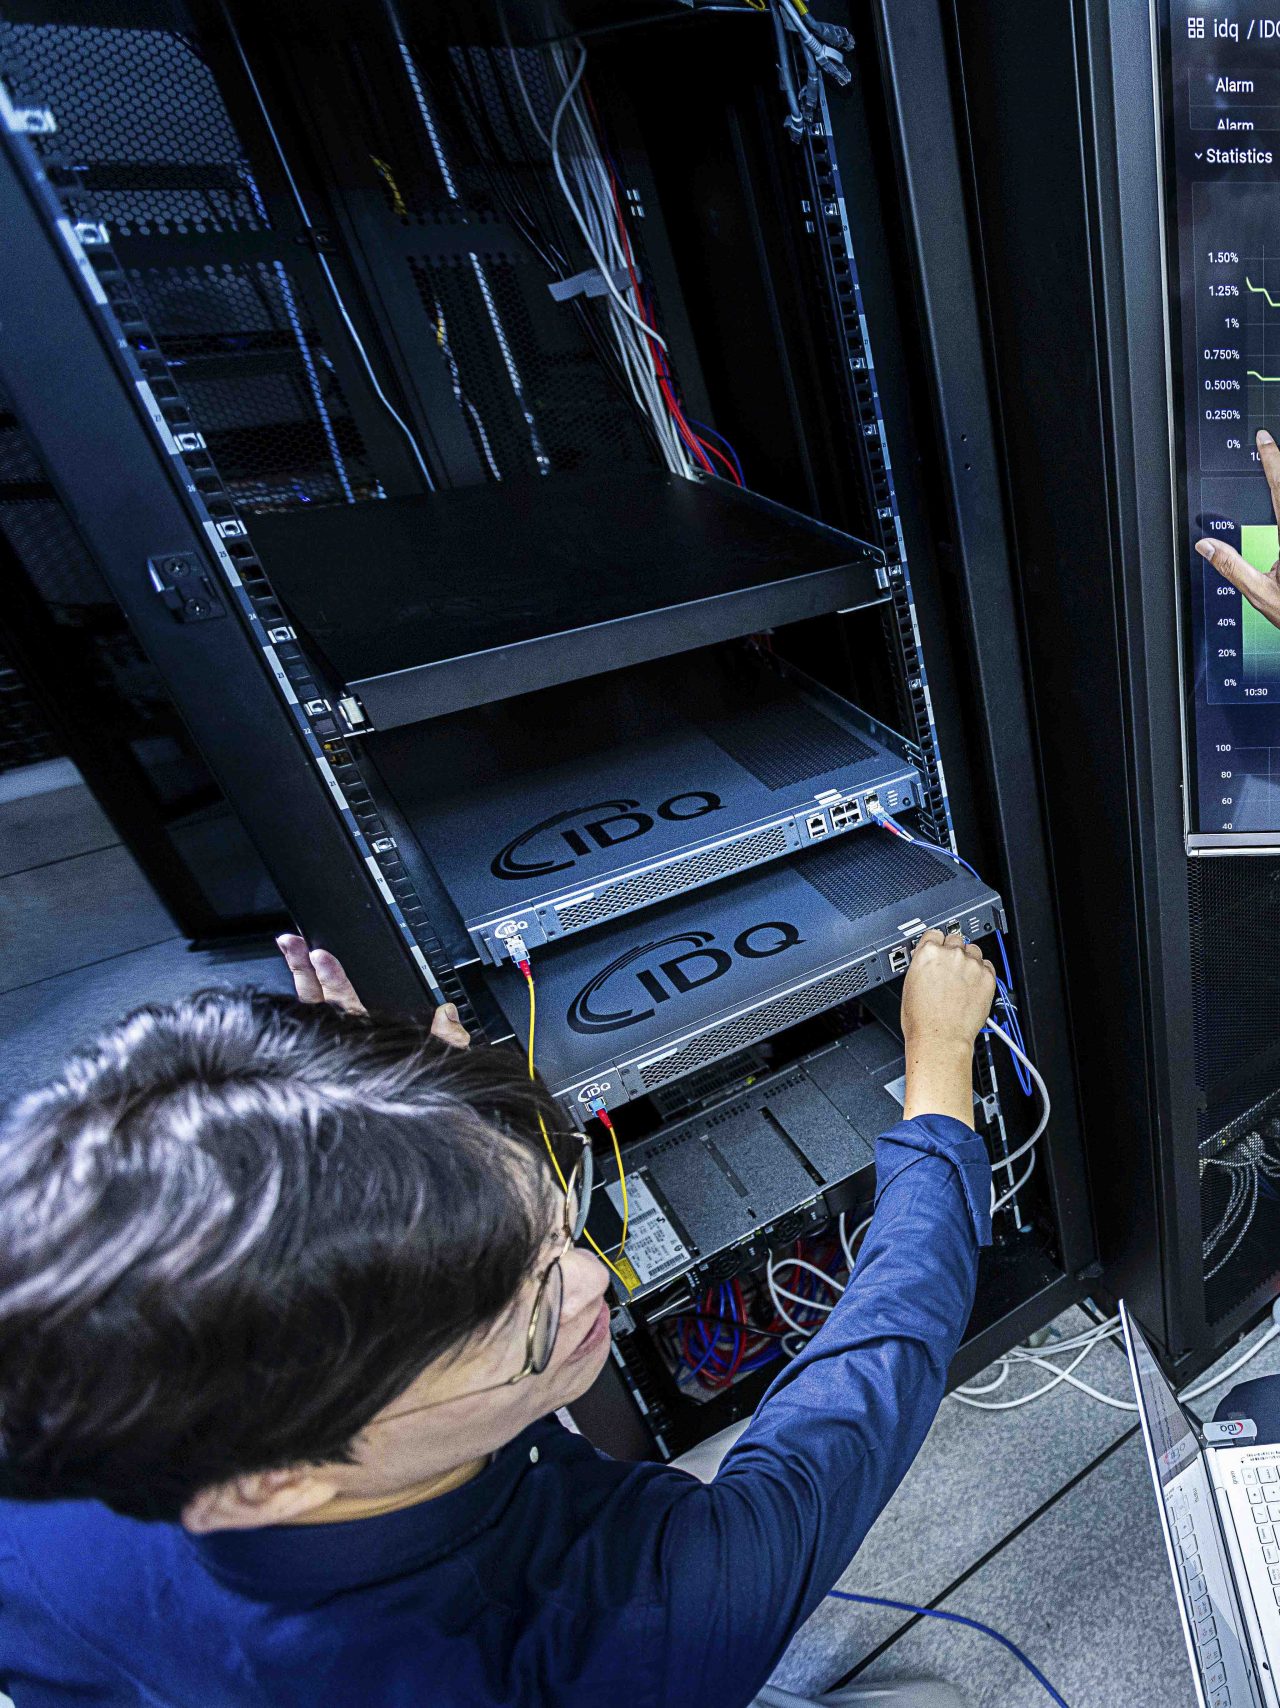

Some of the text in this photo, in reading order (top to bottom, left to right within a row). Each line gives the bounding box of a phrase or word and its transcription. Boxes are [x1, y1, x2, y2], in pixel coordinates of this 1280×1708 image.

[1214, 18, 1238, 42] idq
[1216, 77, 1254, 92] Alarm
[1206, 149, 1272, 163] Statistics
[1208, 252, 1239, 263] 1.50%
[1209, 286, 1239, 296] 1.25%
[1224, 318, 1240, 328] 1%
[1204, 350, 1240, 360] 0.750%
[1205, 380, 1240, 391] 0.500%
[1206, 410, 1240, 420] 0.250%
[1226, 440, 1240, 449] 0%
[1209, 521, 1235, 530] 100%
[1216, 587, 1236, 595] 60%
[1217, 618, 1236, 626] 40%
[1218, 649, 1236, 658] 20%
[1224, 678, 1237, 687] 0%
[1244, 688, 1268, 697] 10:30
[1221, 770, 1232, 779] 80
[1222, 797, 1232, 805] 60
[560, 791, 728, 856] IDQ
[636, 922, 807, 1004] IDQ
